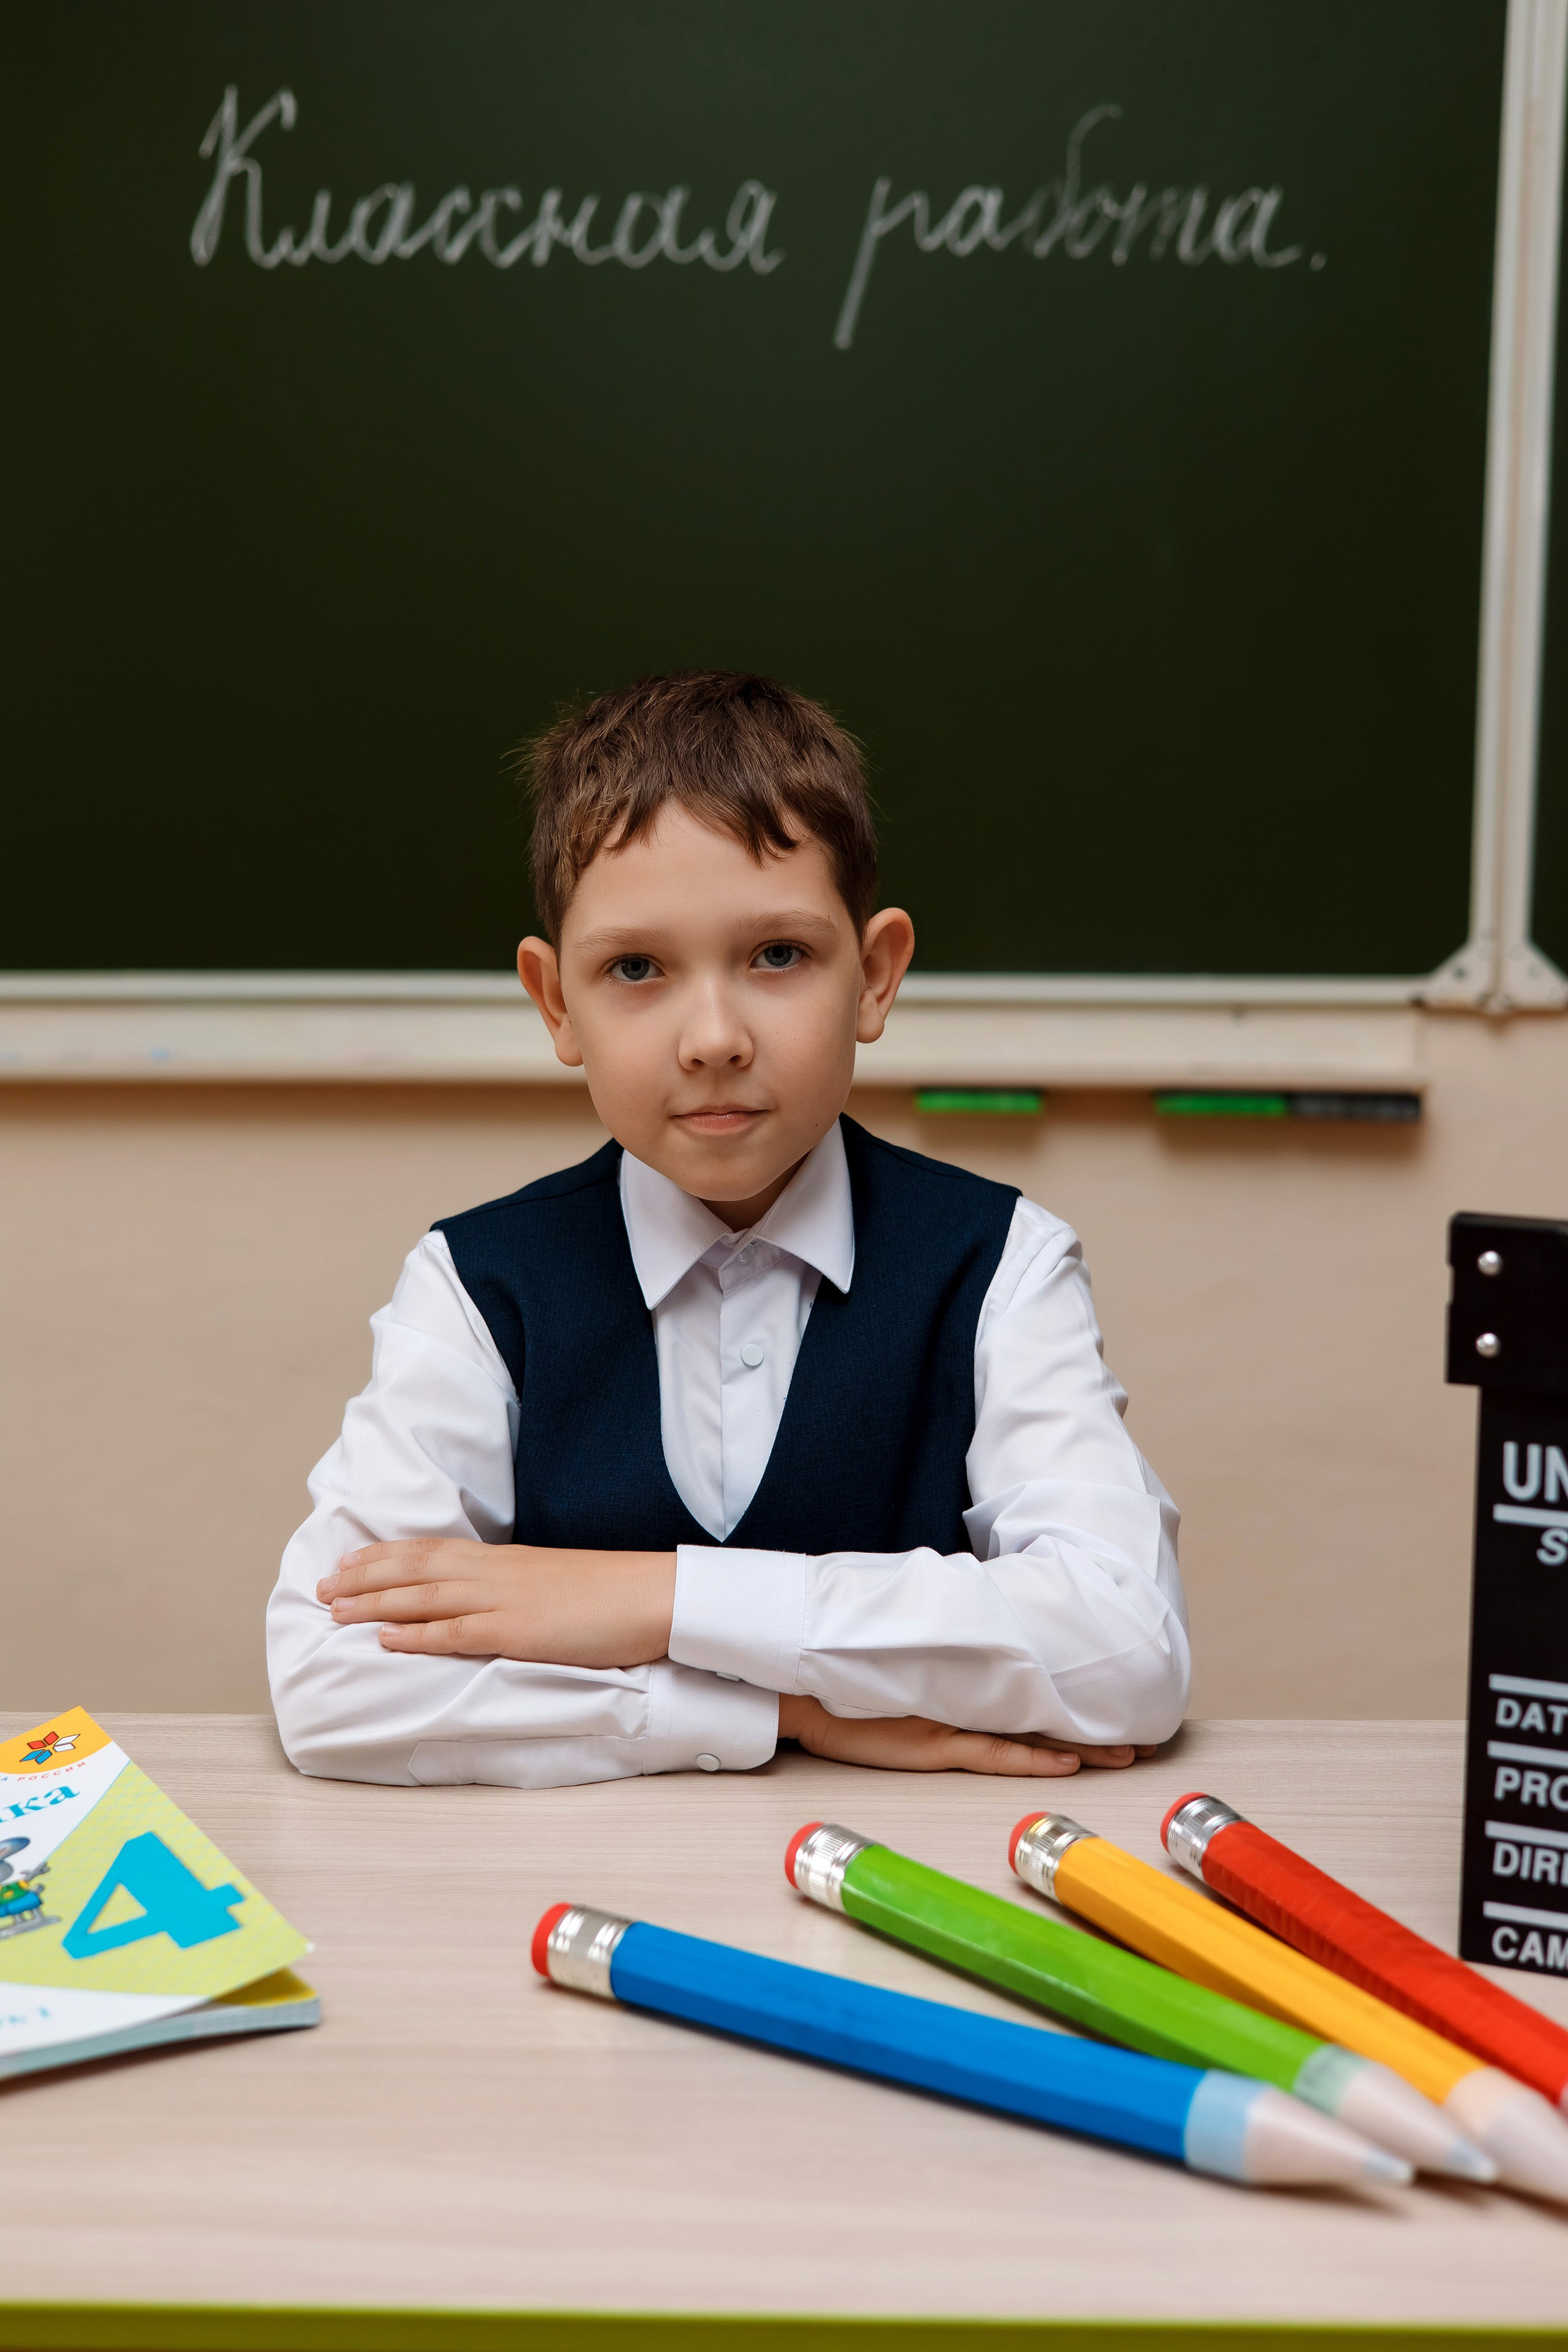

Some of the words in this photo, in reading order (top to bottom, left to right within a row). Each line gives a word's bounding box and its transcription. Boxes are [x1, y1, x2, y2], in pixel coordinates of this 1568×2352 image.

[190, 83, 785, 274] Классная
[834, 103, 1327, 350] работа.
[1503, 1441, 1568, 1503] UN
[1536, 1528, 1568, 1566] S
[1495, 1698, 1568, 1736] DAT
[17, 1762, 86, 1781] РОССИИ
[0, 1785, 80, 1823] ка
[62, 1831, 245, 1960] 4
[1491, 1926, 1568, 1970] CAM
